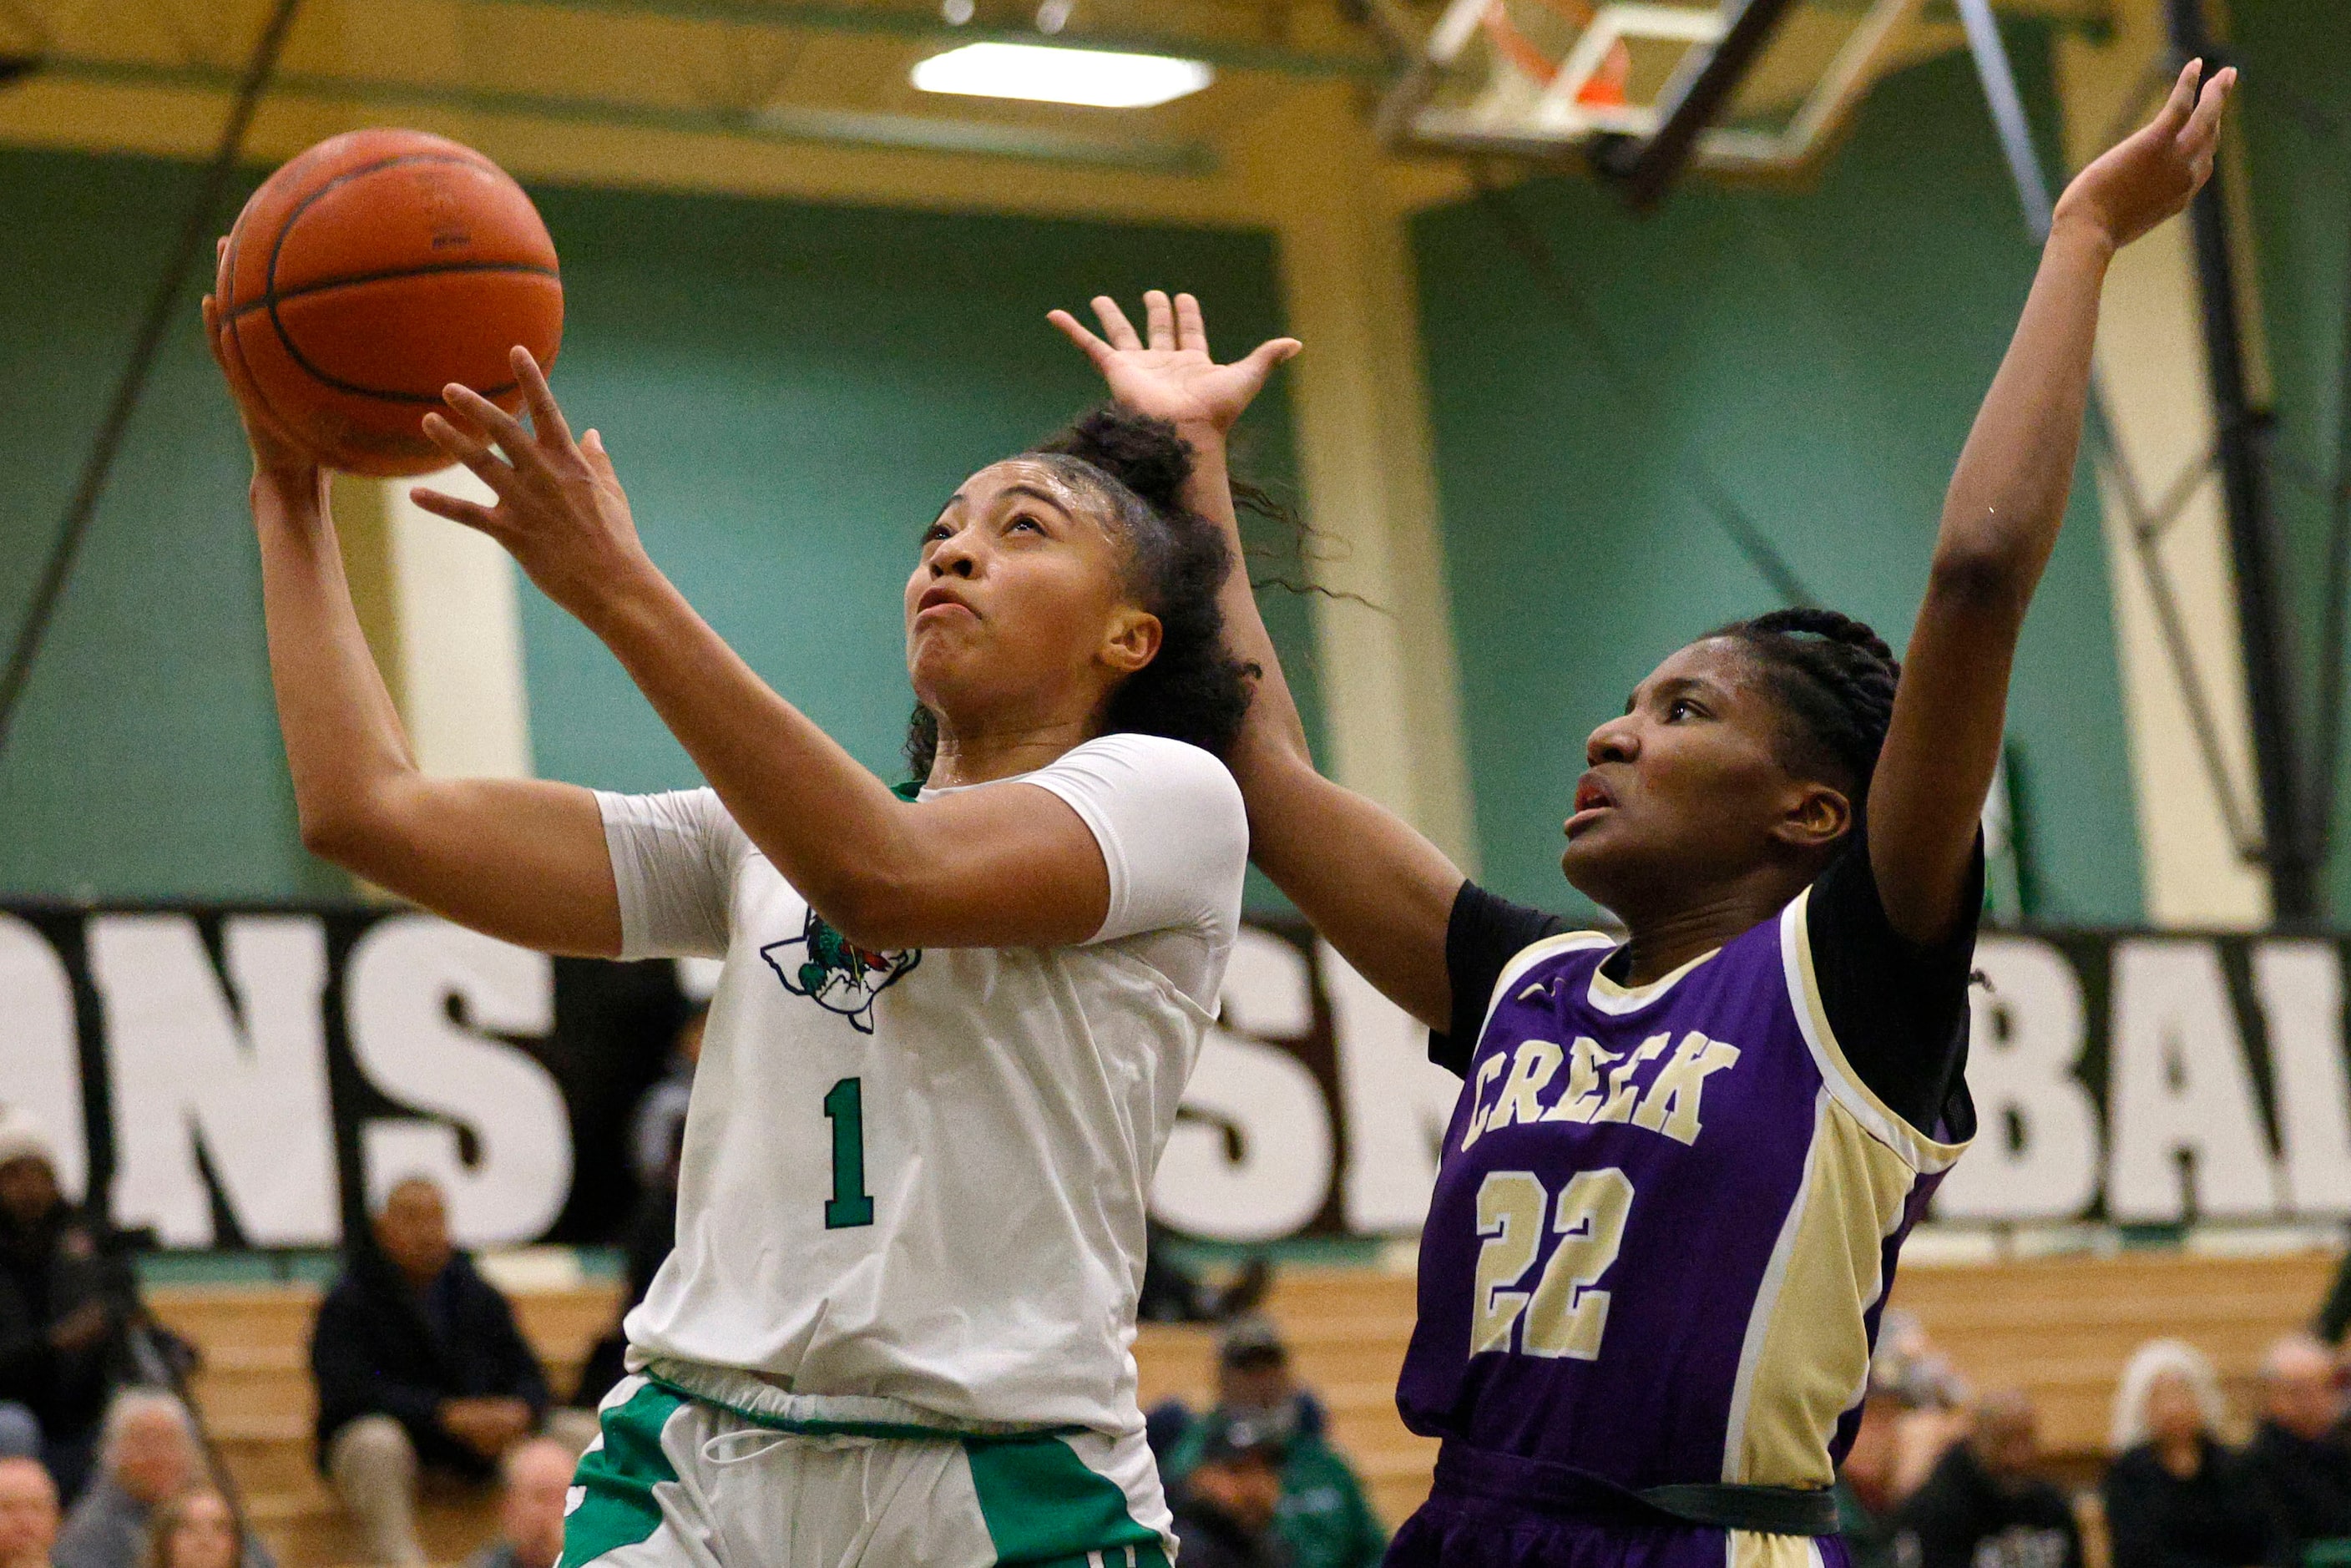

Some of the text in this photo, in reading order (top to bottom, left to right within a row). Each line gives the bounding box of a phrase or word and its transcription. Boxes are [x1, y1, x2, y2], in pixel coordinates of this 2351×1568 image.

[823, 1076, 874, 1229] 1
[1460, 1029, 1742, 1153] CREEK
[1469, 1166, 1636, 1361] 22
